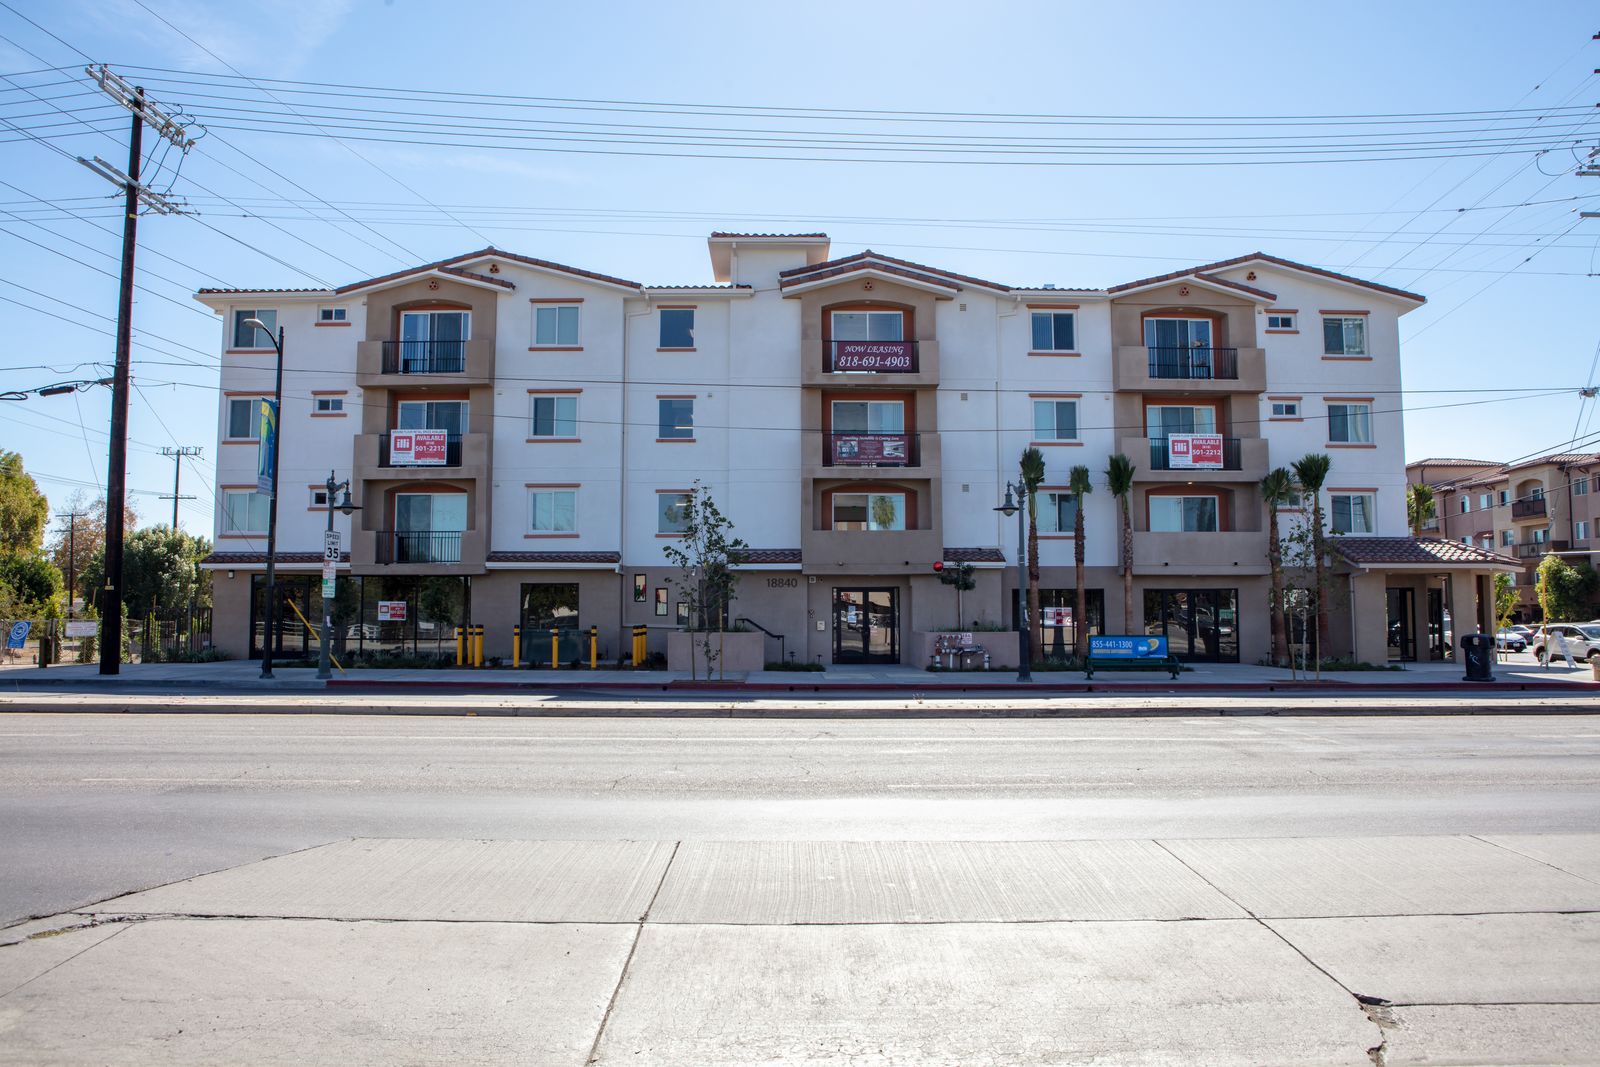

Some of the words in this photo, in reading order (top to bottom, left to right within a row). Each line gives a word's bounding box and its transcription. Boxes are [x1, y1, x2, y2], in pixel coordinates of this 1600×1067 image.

[845, 345, 867, 353] NOW
[867, 345, 904, 355] LEASING
[839, 355, 910, 367] 818-691-4903
[326, 547, 339, 559] 35
[766, 577, 798, 588] 18840
[1091, 640, 1133, 648] 855-441-1300
